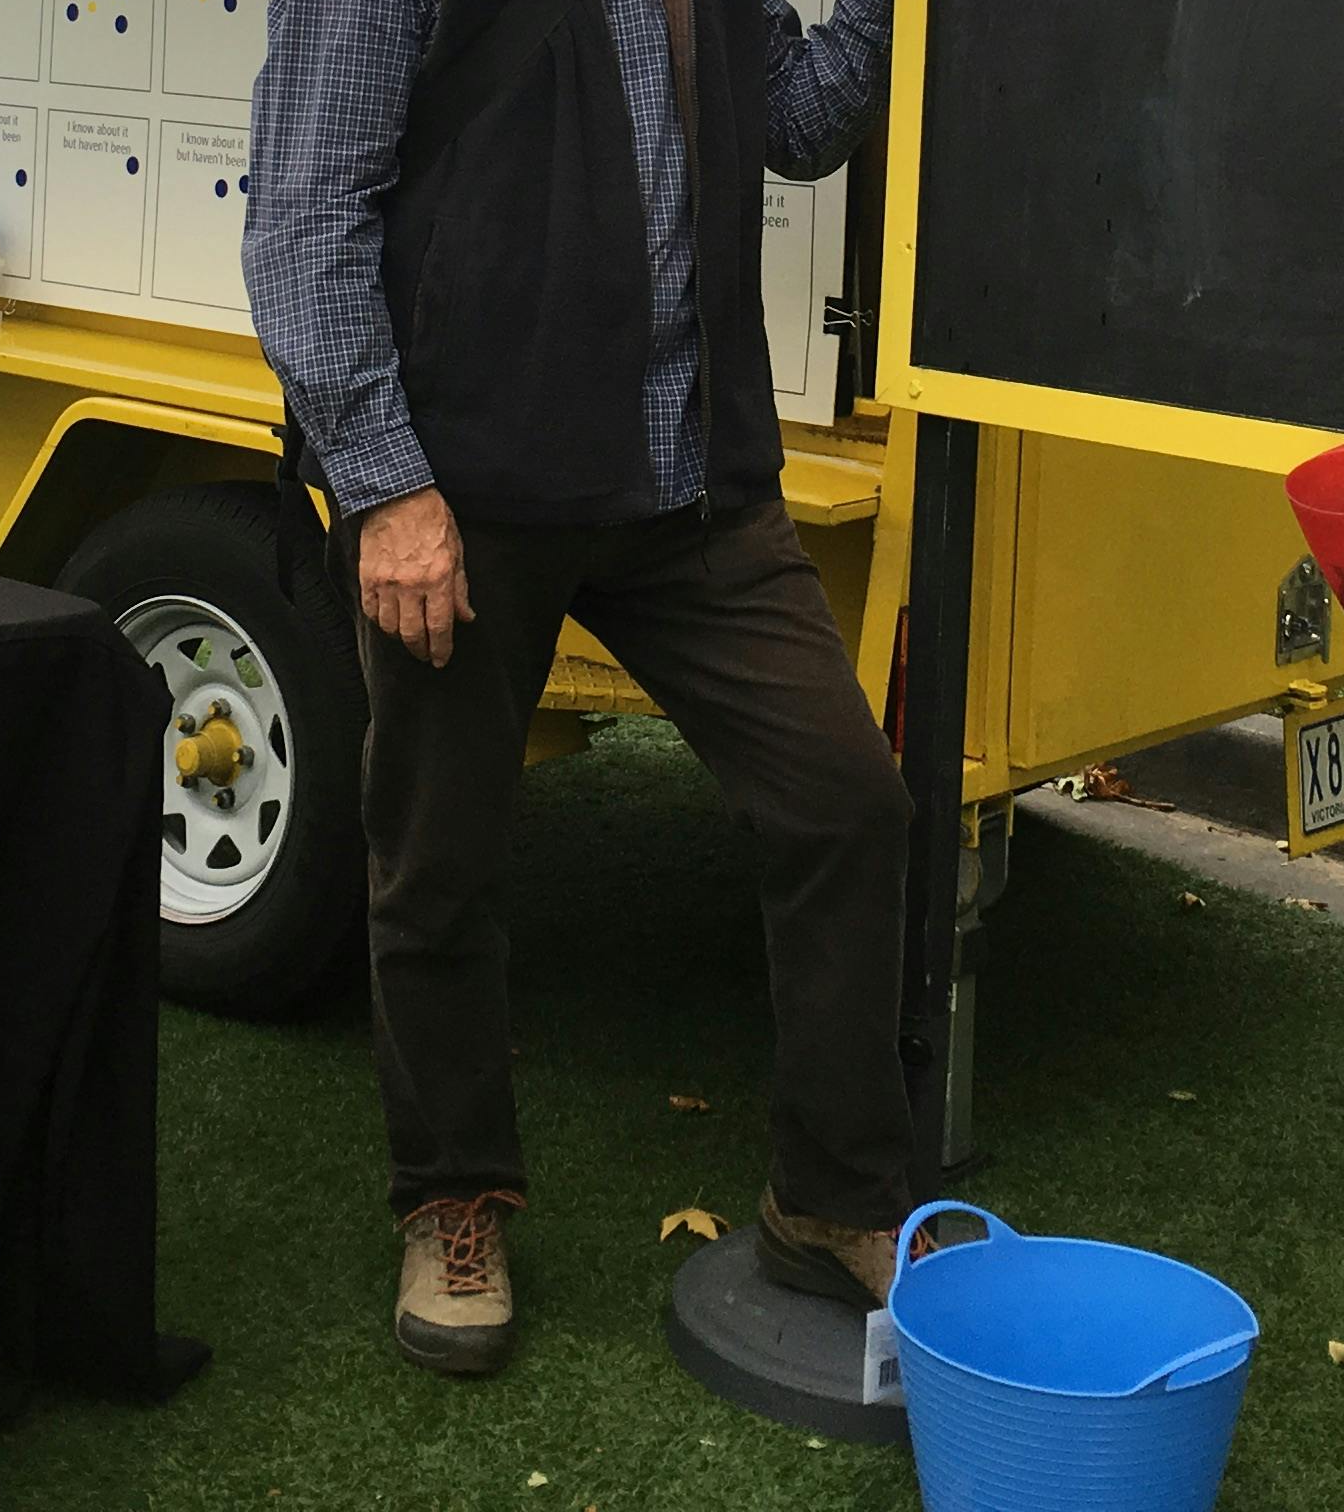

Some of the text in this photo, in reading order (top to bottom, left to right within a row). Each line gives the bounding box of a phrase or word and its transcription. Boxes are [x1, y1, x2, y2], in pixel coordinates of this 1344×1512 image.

[186, 133, 208, 146] know
[211, 134, 235, 149] about
[238, 138, 244, 150] it
[177, 149, 247, 168] but haven't been
